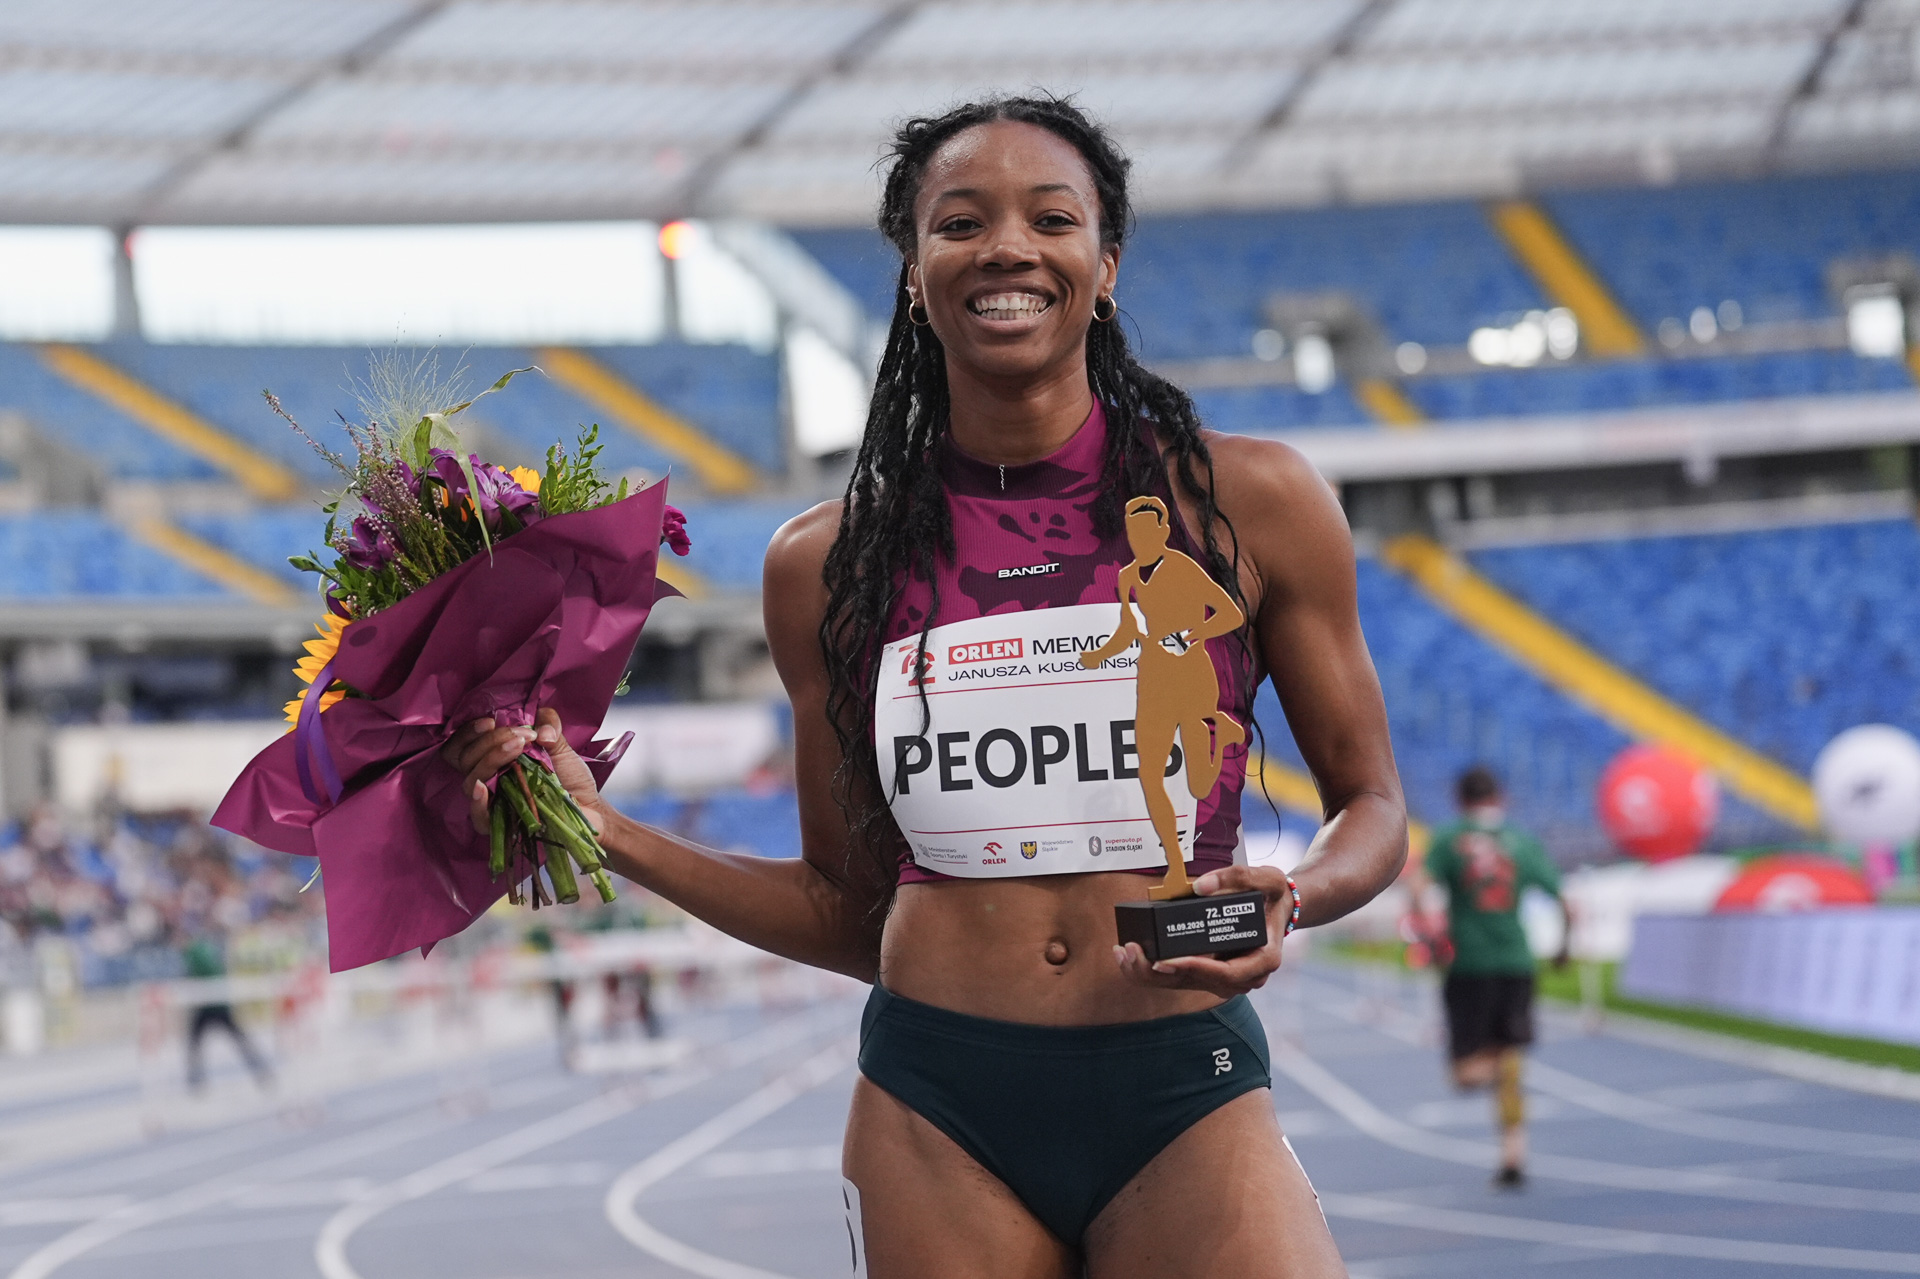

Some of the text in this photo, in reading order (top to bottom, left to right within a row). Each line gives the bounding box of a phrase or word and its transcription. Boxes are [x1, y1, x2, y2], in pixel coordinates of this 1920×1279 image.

[998, 563, 1060, 579] BANDIT
[951, 640, 1020, 662] ORLEN
[948, 665, 1032, 682] JANUSZA
[1205, 905, 1253, 919] 72. ORLEN
[1207, 917, 1239, 926] MEMORIAŁ
[1208, 926, 1235, 935] JANUSZA
[1209, 930, 1257, 942] KUSOCIŃSKIEGO
